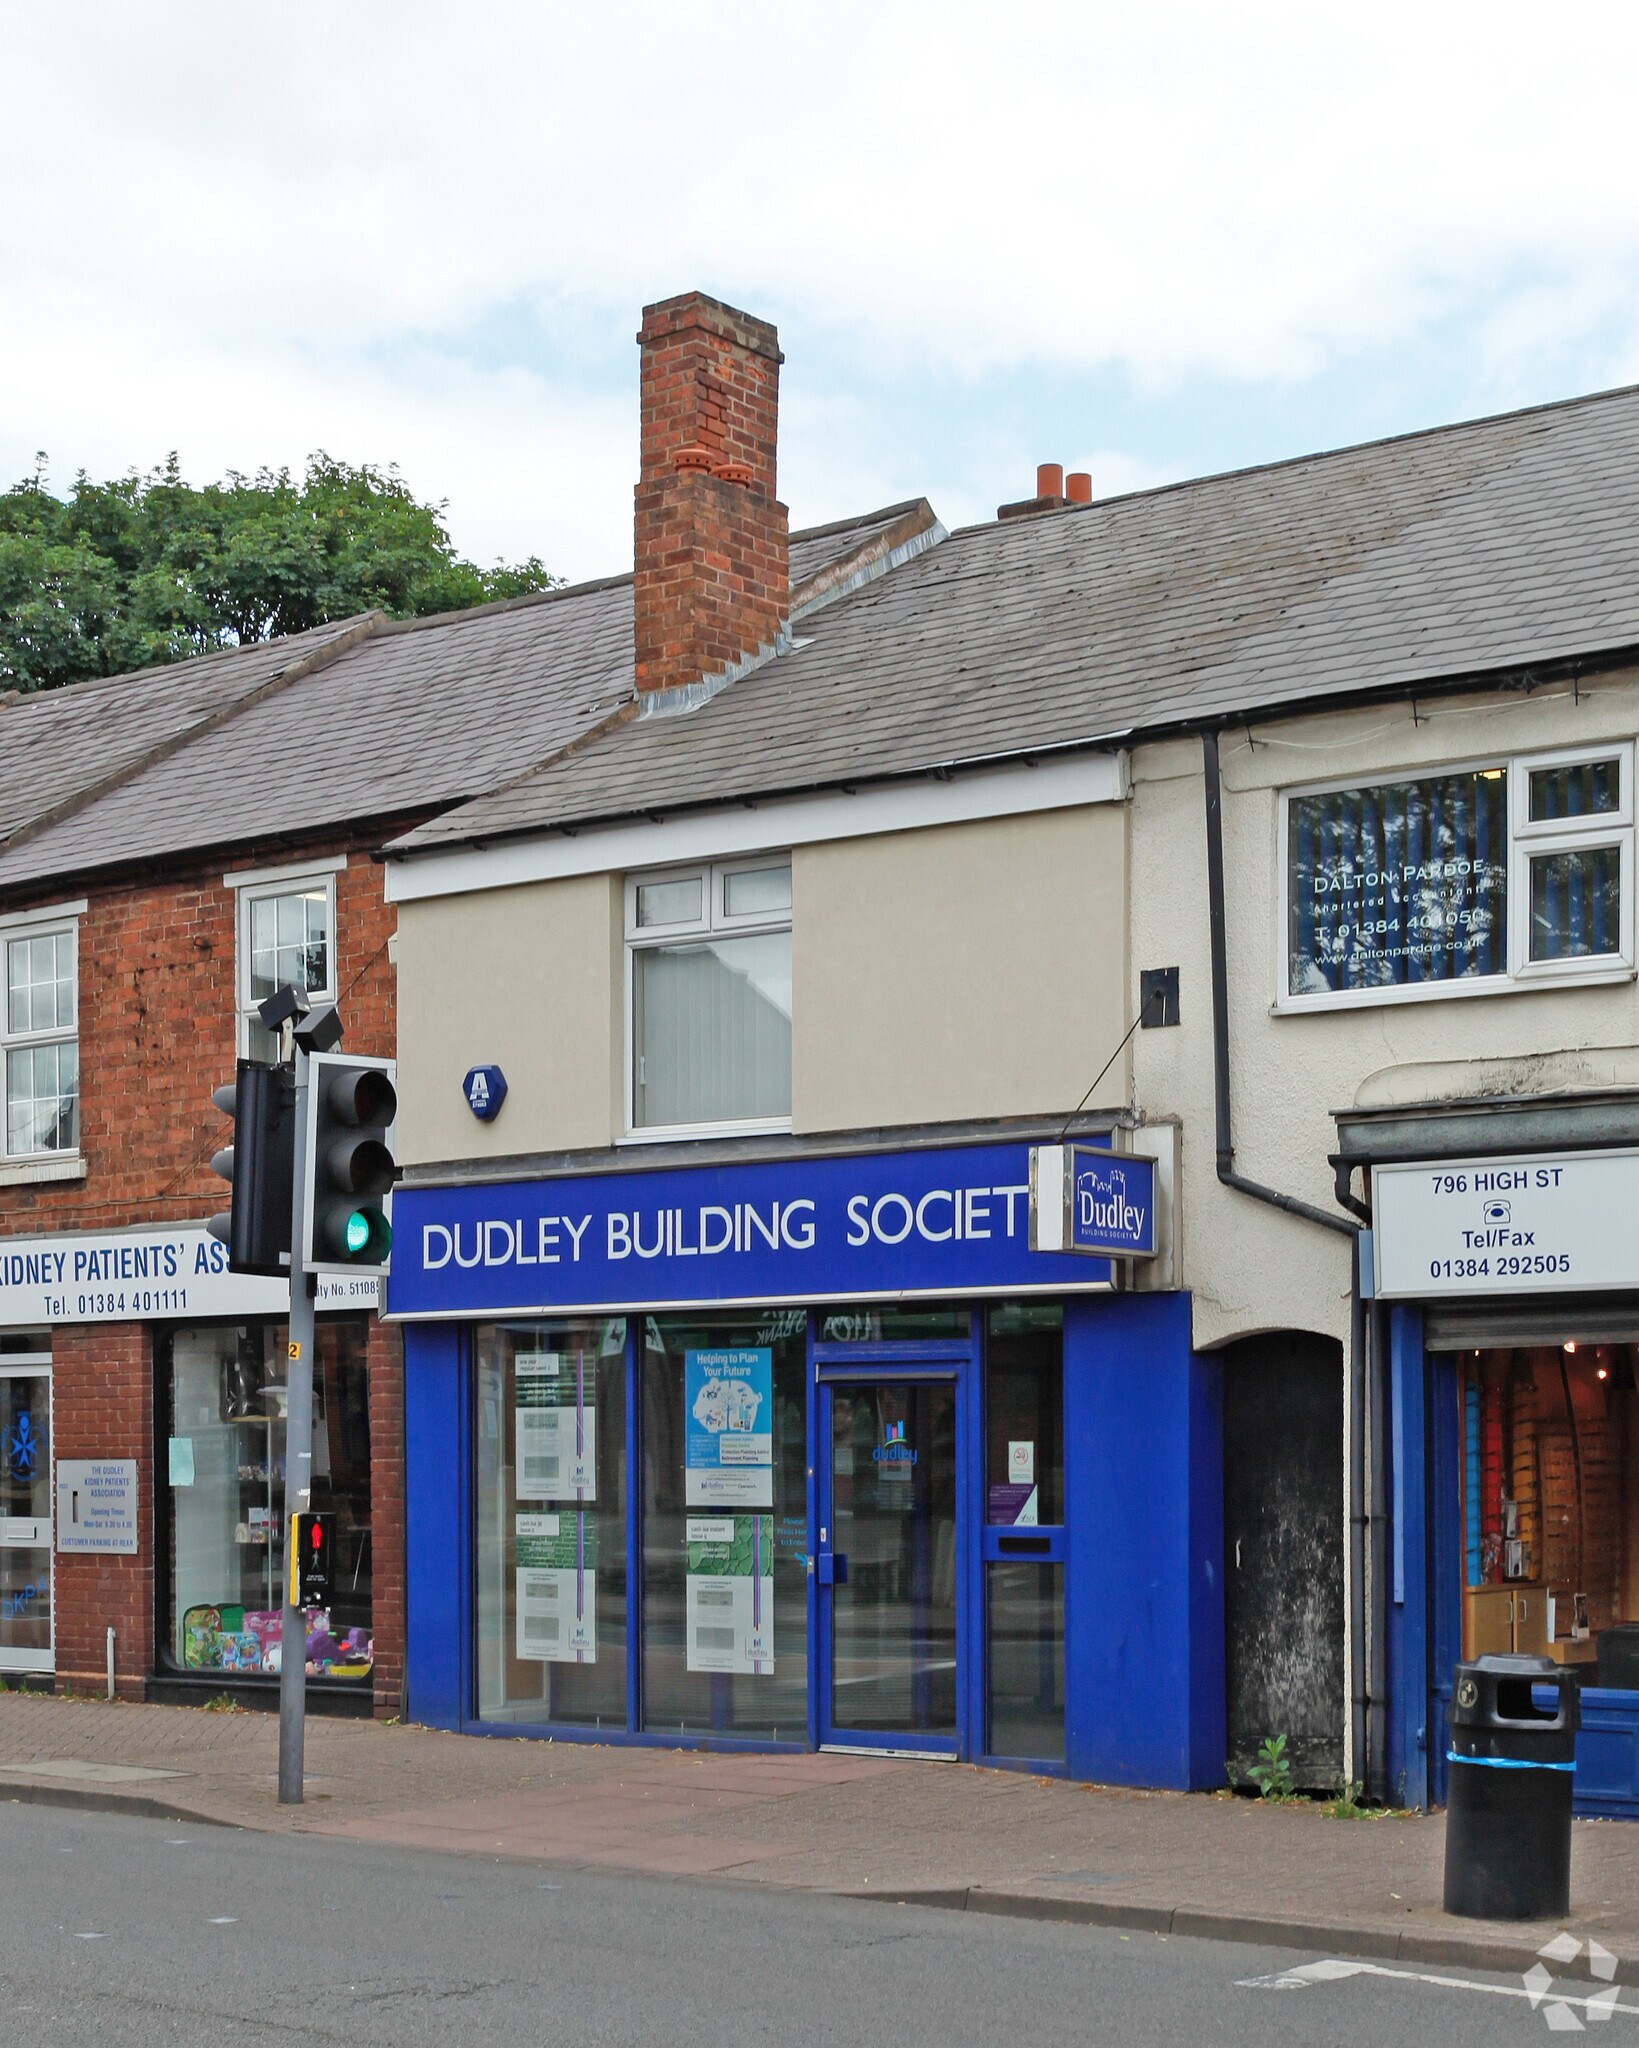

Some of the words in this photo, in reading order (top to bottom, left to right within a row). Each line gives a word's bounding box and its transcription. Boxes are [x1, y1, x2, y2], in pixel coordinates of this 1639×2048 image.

[1314, 870, 1393, 893] DALTON
[1403, 859, 1484, 882] PARDOE
[1338, 918, 1400, 938] 01384
[1406, 909, 1484, 929] 401050
[1432, 1175, 1467, 1194] 796
[1474, 1171, 1528, 1192] HIGH
[1535, 1168, 1564, 1188] ST
[1080, 1190, 1145, 1240] Dudley
[423, 1214, 592, 1270] DUDLEY
[607, 1199, 816, 1261] BUILDING
[1081, 1228, 1108, 1238] BUILDING
[1109, 1231, 1133, 1240] SOCIETY
[1462, 1229, 1535, 1249] Tel/Fax
[1430, 1258, 1490, 1278] 01384
[1496, 1254, 1571, 1276] 292505
[331, 1283, 346, 1296] No.
[44, 1296, 71, 1316] Tel.
[78, 1293, 126, 1314] 01384
[132, 1289, 187, 1312] 401111
[289, 1344, 298, 1358] 2
[697, 1353, 728, 1365] Helping
[729, 1354, 738, 1363] to
[739, 1352, 759, 1364] Plan
[703, 1366, 722, 1377] Your
[723, 1366, 751, 1376] Future
[872, 1443, 918, 1466] dudley
[92, 1466, 102, 1475] THE
[102, 1466, 124, 1475] DUDLEY
[84, 1477, 103, 1487] KIDNEY
[90, 1488, 126, 1498] ASSOCIATION
[90, 1507, 110, 1517] Opening
[111, 1507, 125, 1516] Times
[61, 1538, 88, 1547] CUSTOMER
[89, 1538, 111, 1547] PARKING
